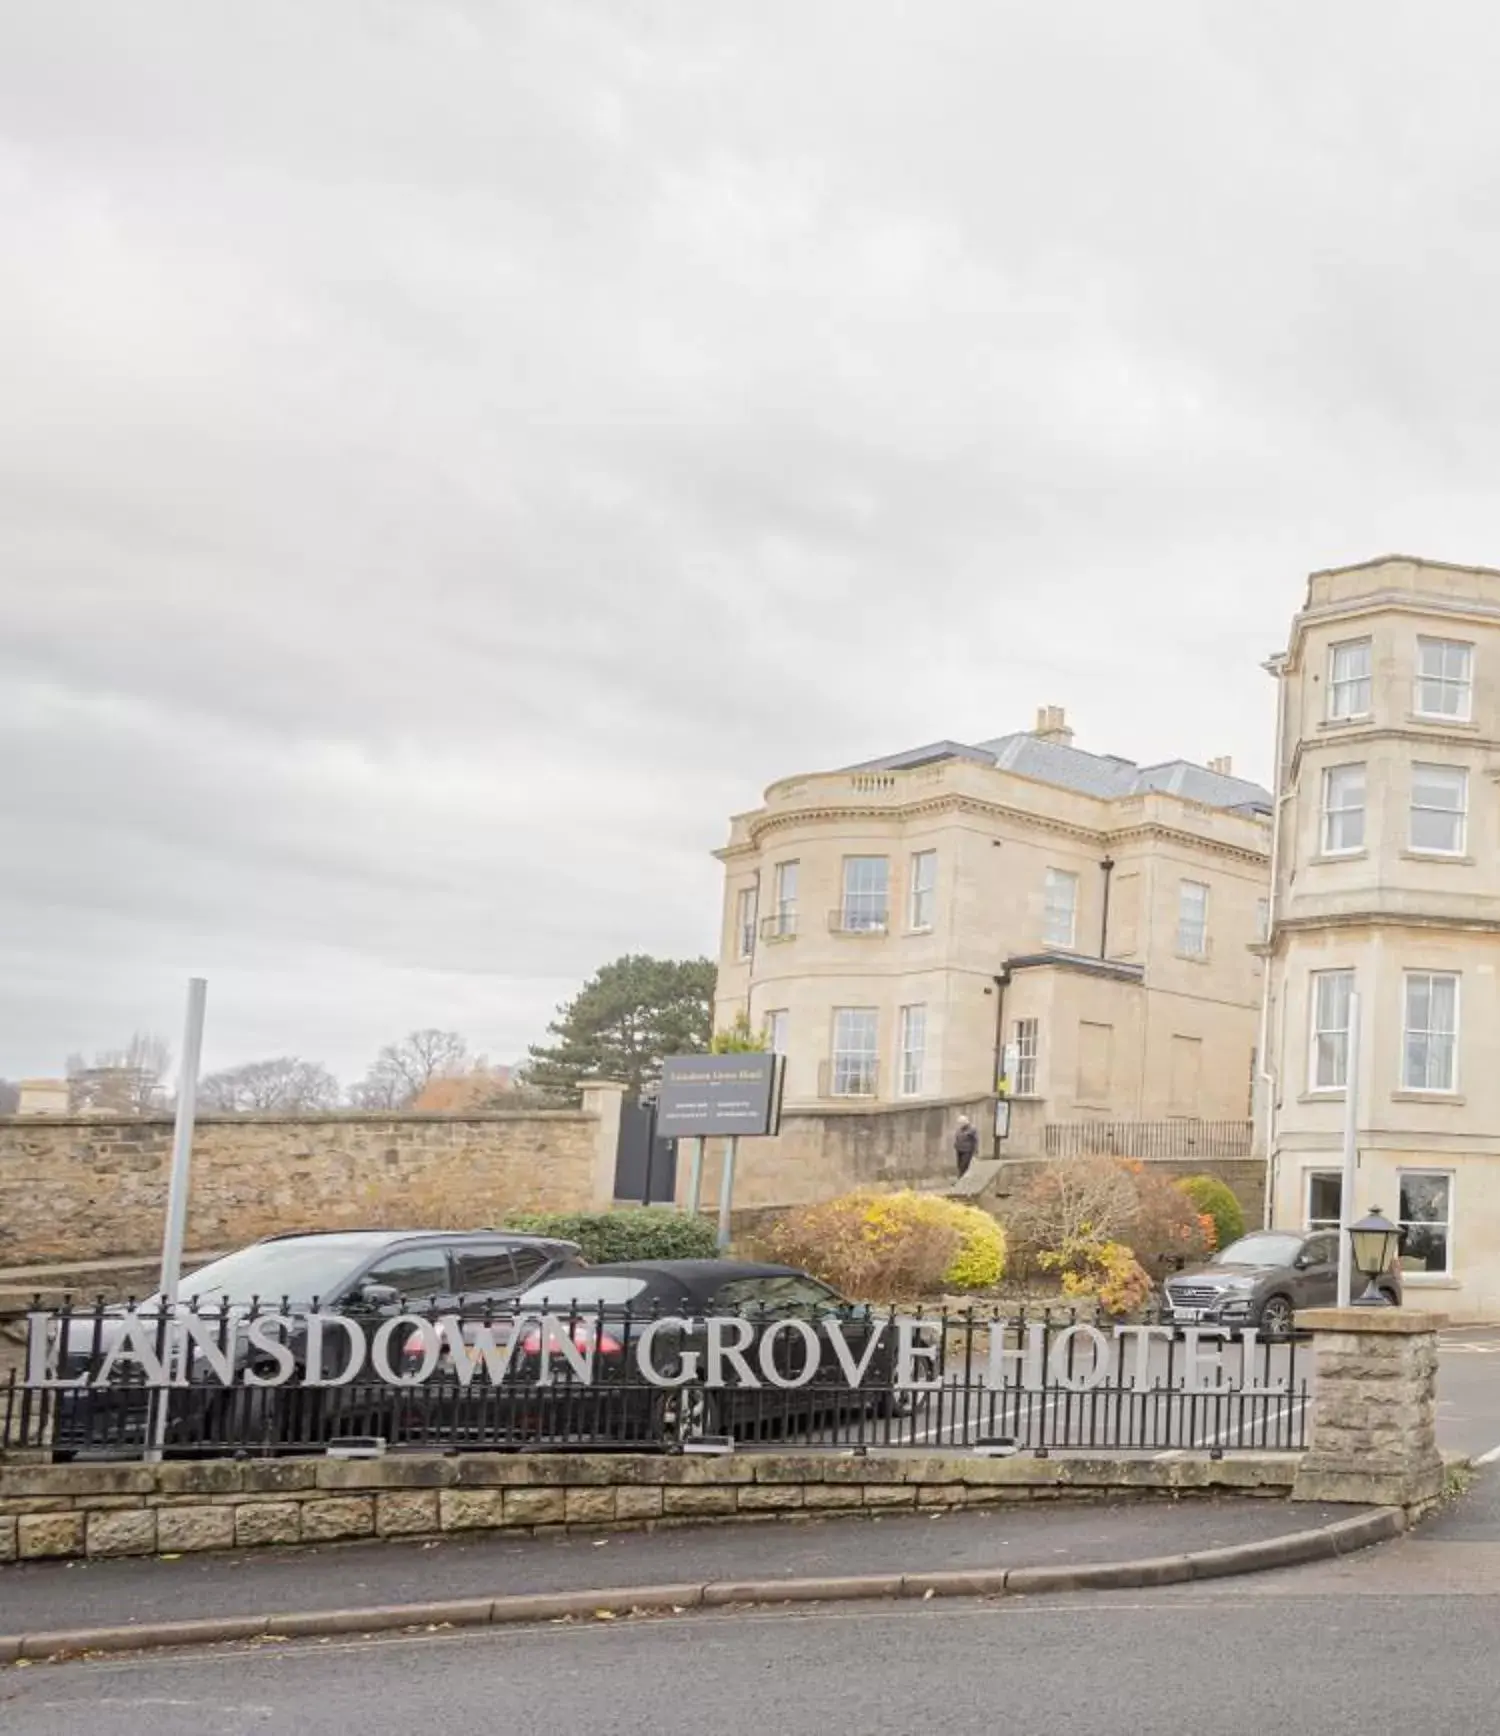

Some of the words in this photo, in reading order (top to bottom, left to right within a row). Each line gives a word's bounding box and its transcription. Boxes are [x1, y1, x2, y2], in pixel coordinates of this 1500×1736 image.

[25, 1311, 600, 1388] LANSDOWN
[635, 1315, 943, 1391] GROVE
[986, 1321, 1290, 1396] HOTEL
